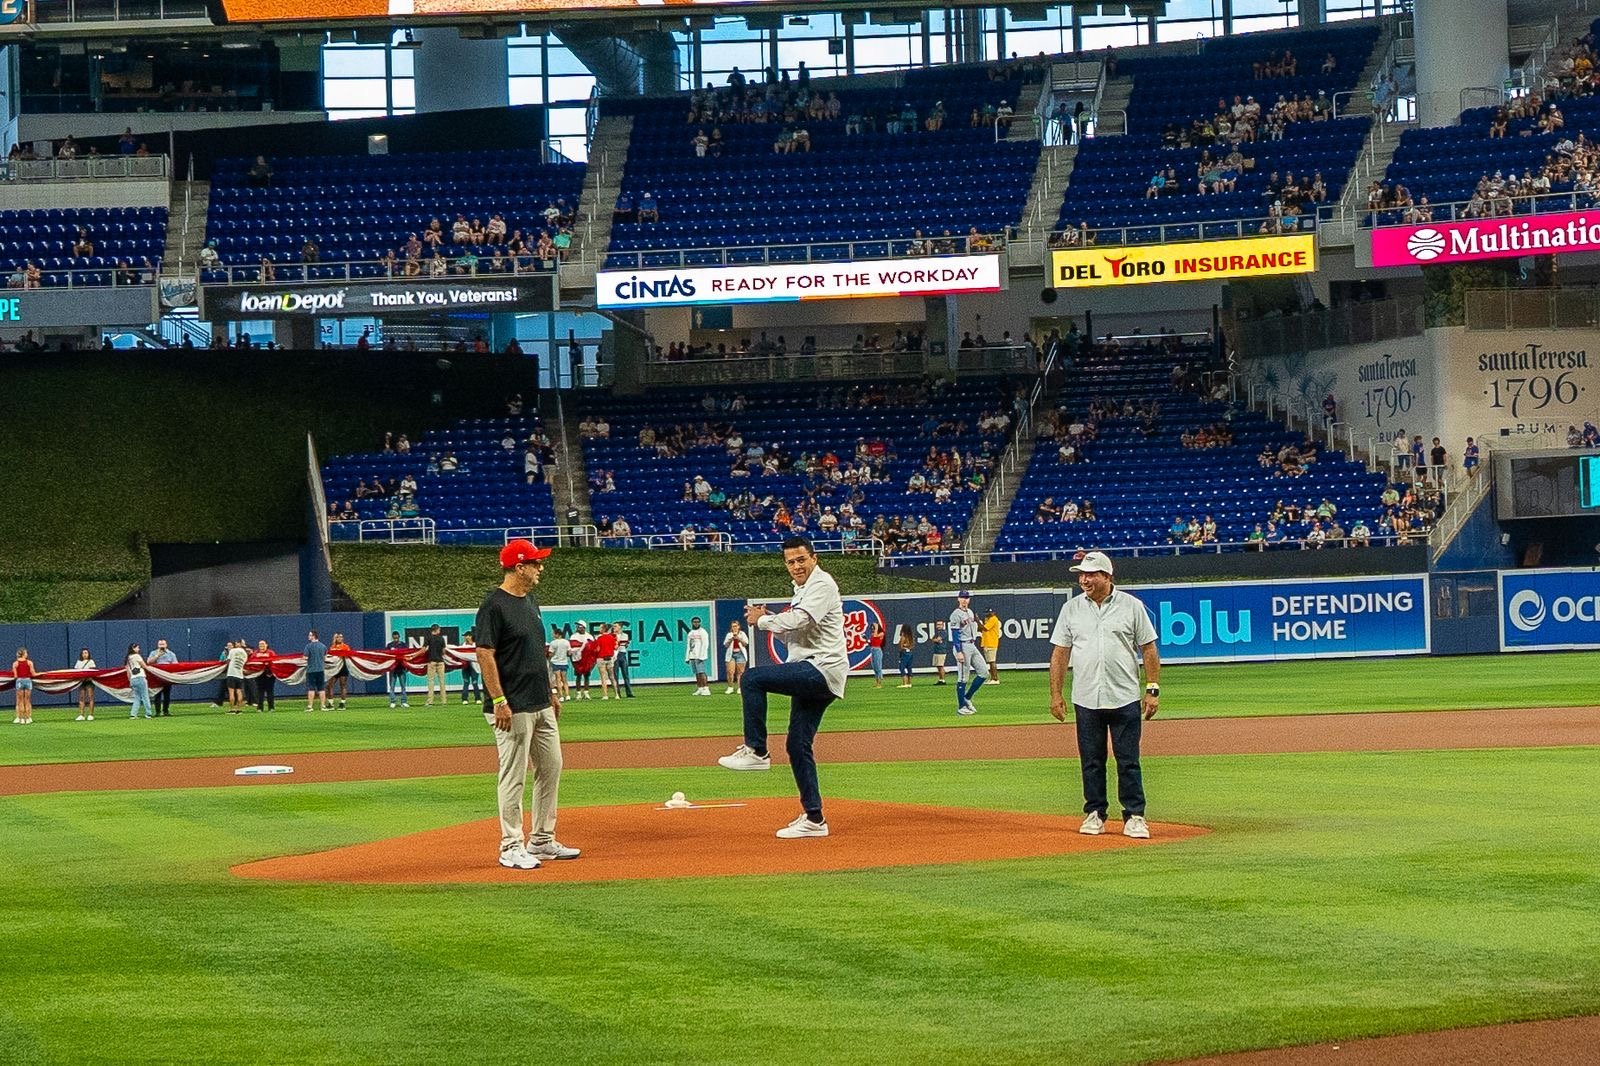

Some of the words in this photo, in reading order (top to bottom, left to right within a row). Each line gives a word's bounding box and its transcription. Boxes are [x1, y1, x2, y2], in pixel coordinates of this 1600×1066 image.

[1061, 265, 1101, 281] DEL
[1104, 255, 1165, 279] TORO
[1174, 251, 1307, 275] INSURANCE
[712, 277, 777, 292] READY
[786, 275, 825, 289] FOR
[833, 273, 870, 287] THE
[878, 267, 979, 284] WORKDAY
[240, 290, 346, 314] loanDepot
[371, 292, 415, 306] Thank
[416, 291, 448, 305] You,
[448, 288, 518, 303] Veterans!
[1516, 423, 1555, 434] RUM
[949, 565, 979, 583] 387
[1271, 591, 1413, 617] DEFENDING
[1160, 600, 1252, 645] blu
[1273, 619, 1347, 641] HOME
